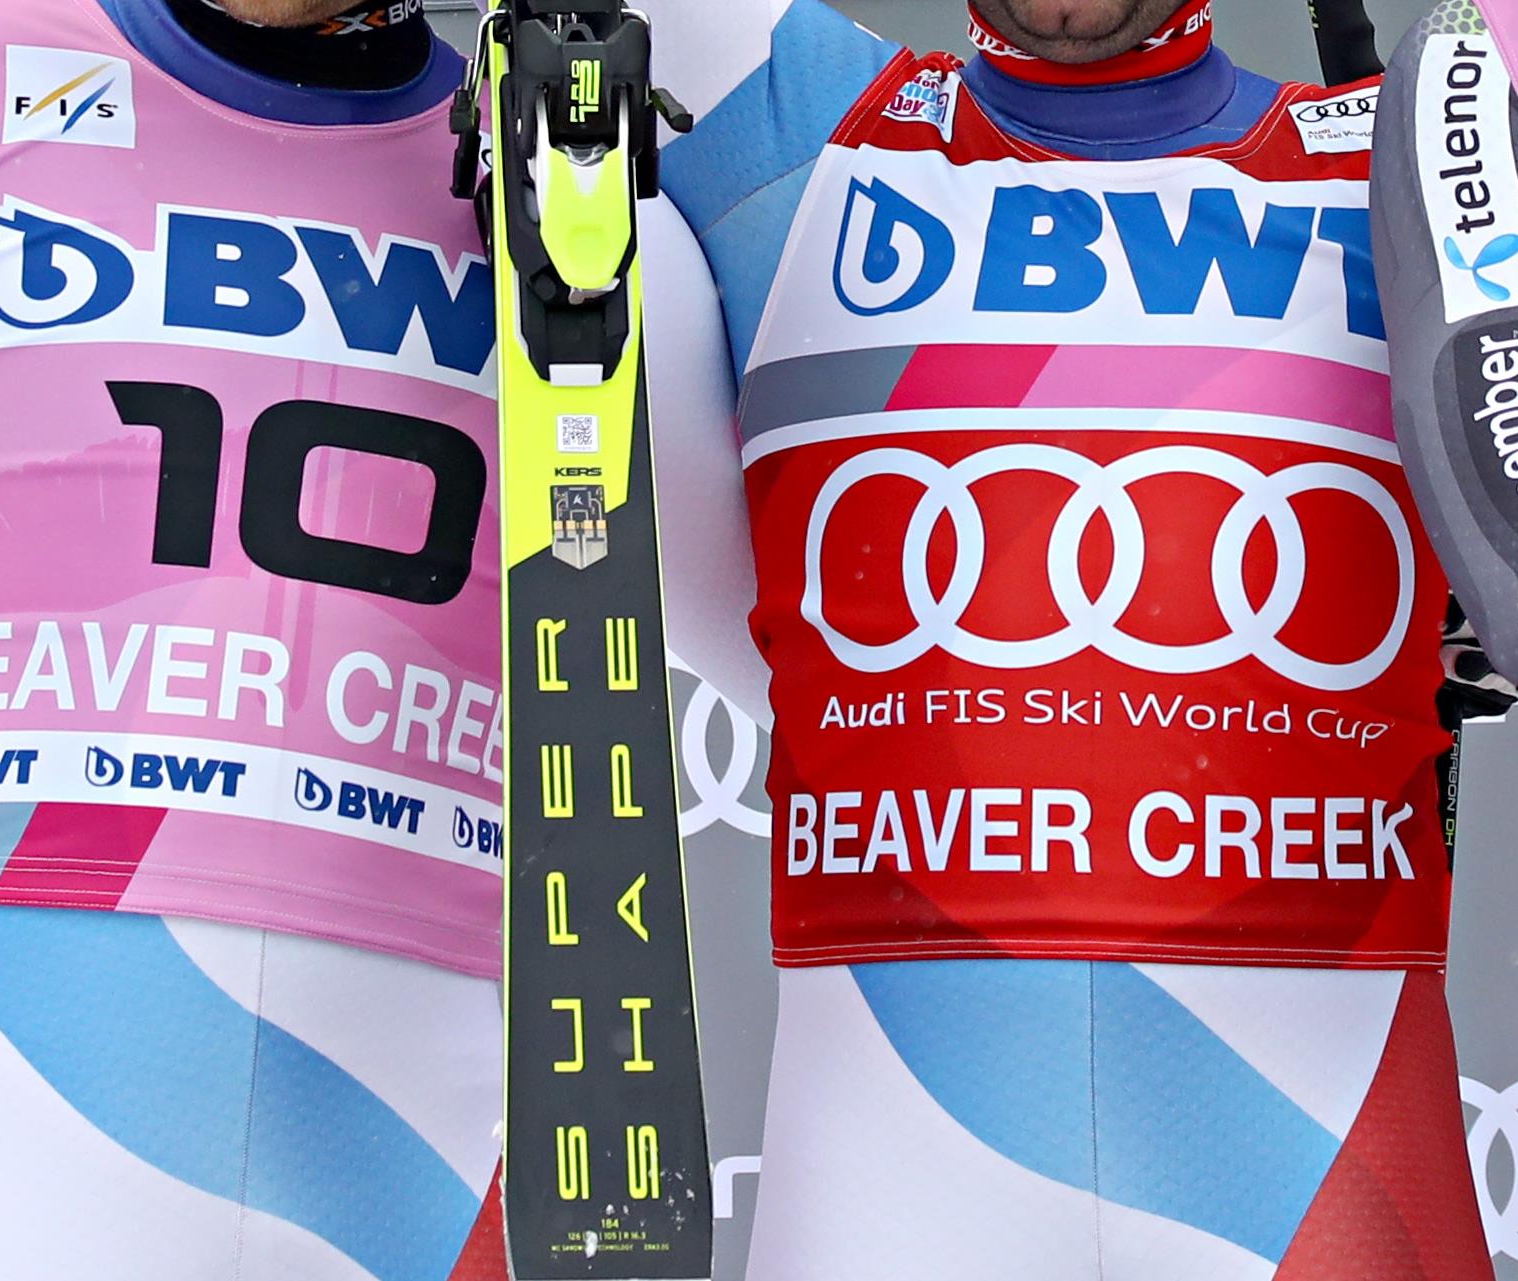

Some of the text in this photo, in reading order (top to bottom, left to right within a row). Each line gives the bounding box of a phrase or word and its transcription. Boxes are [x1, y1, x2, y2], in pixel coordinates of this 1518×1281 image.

[1440, 39, 1489, 234] telenor
[163, 211, 496, 376] BW
[104, 380, 487, 606] 10
[554, 467, 602, 477] KERS
[820, 688, 1393, 749] Audi FIS Ski World Cup
[130, 754, 246, 797] BWT
[338, 781, 425, 834] BWT
[1447, 729, 1460, 812] CARBON
[787, 788, 1414, 880] BEAVER CREEK
[533, 618, 590, 1200] SUPER
[605, 618, 660, 1200] SHAPE
[601, 1218, 620, 1229] 184
